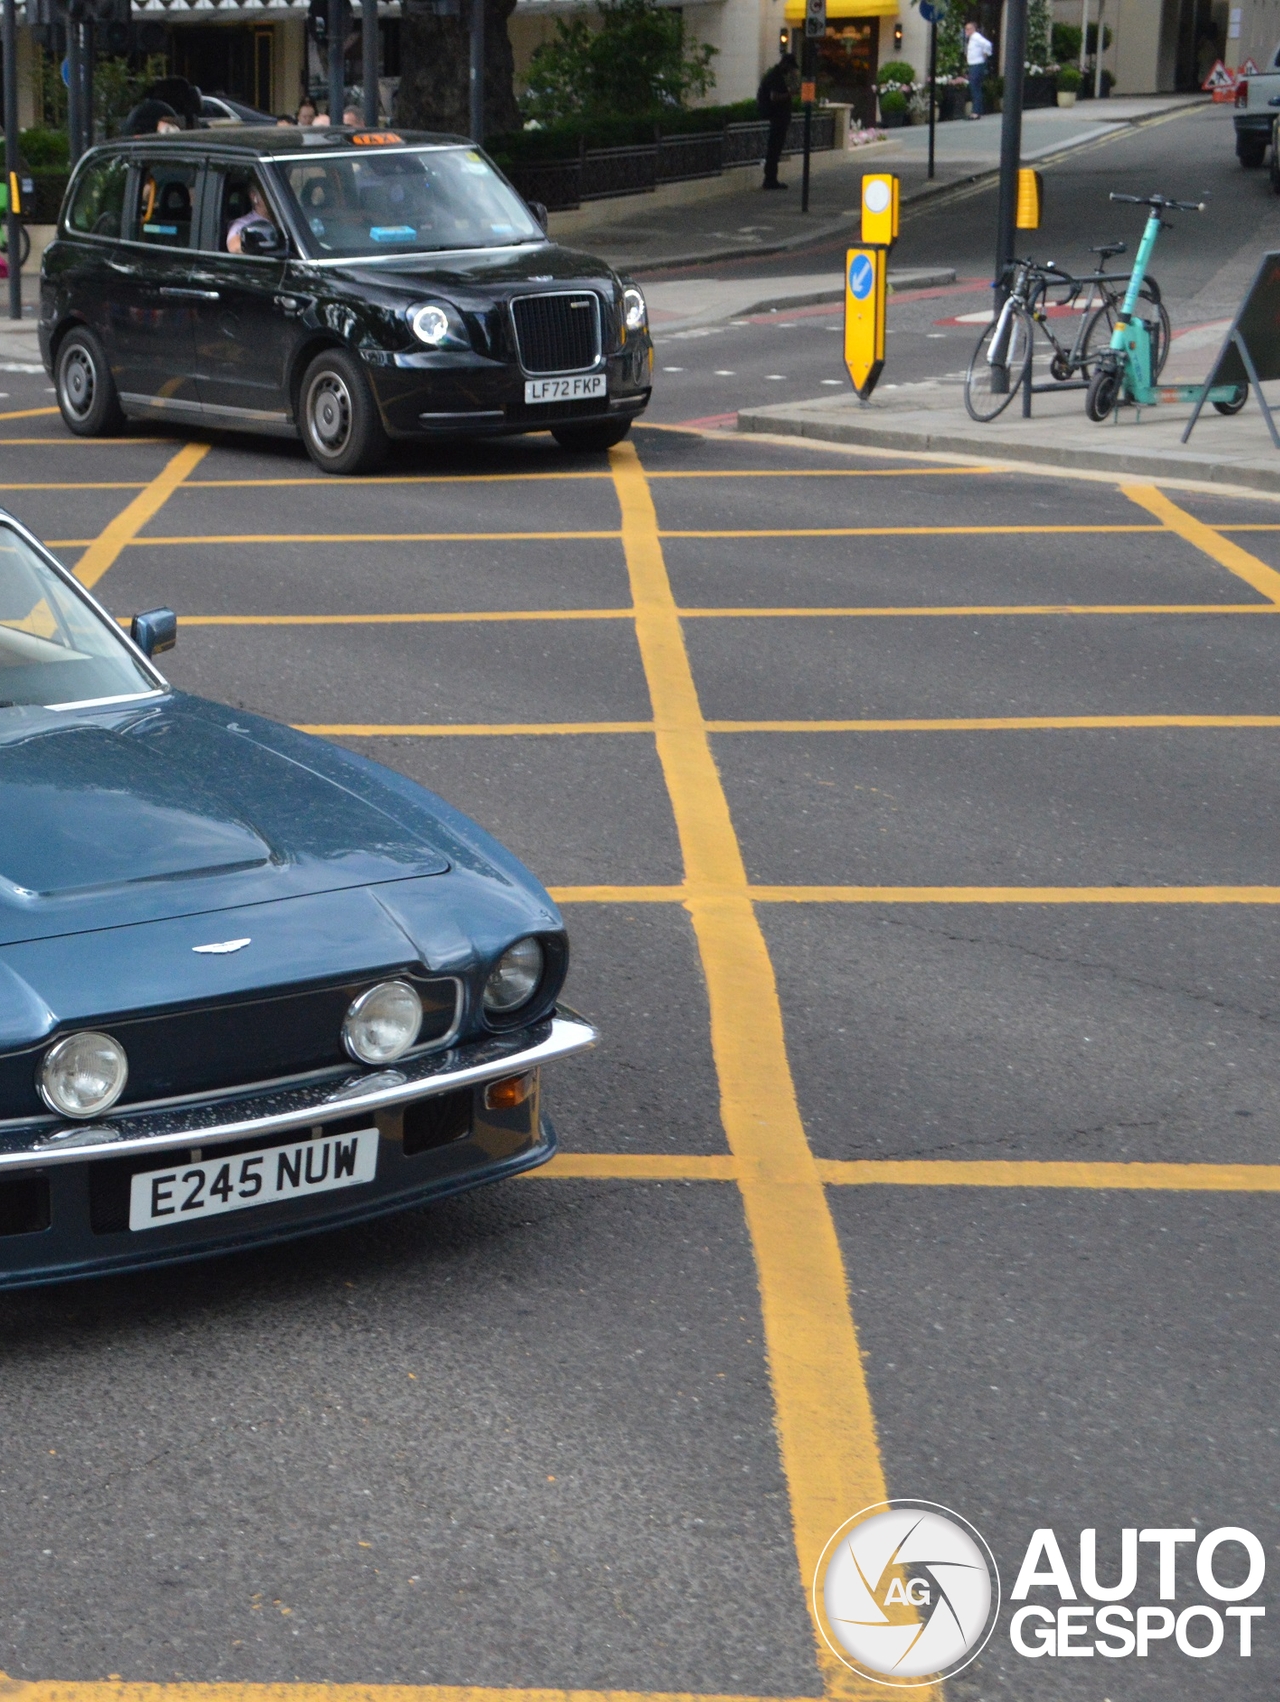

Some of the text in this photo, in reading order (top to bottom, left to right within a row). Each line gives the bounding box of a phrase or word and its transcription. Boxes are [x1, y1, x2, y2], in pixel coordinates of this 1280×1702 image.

[354, 133, 401, 145] TAXI
[532, 378, 601, 399] LF72 FKP
[150, 1137, 359, 1218] E245 NUW
